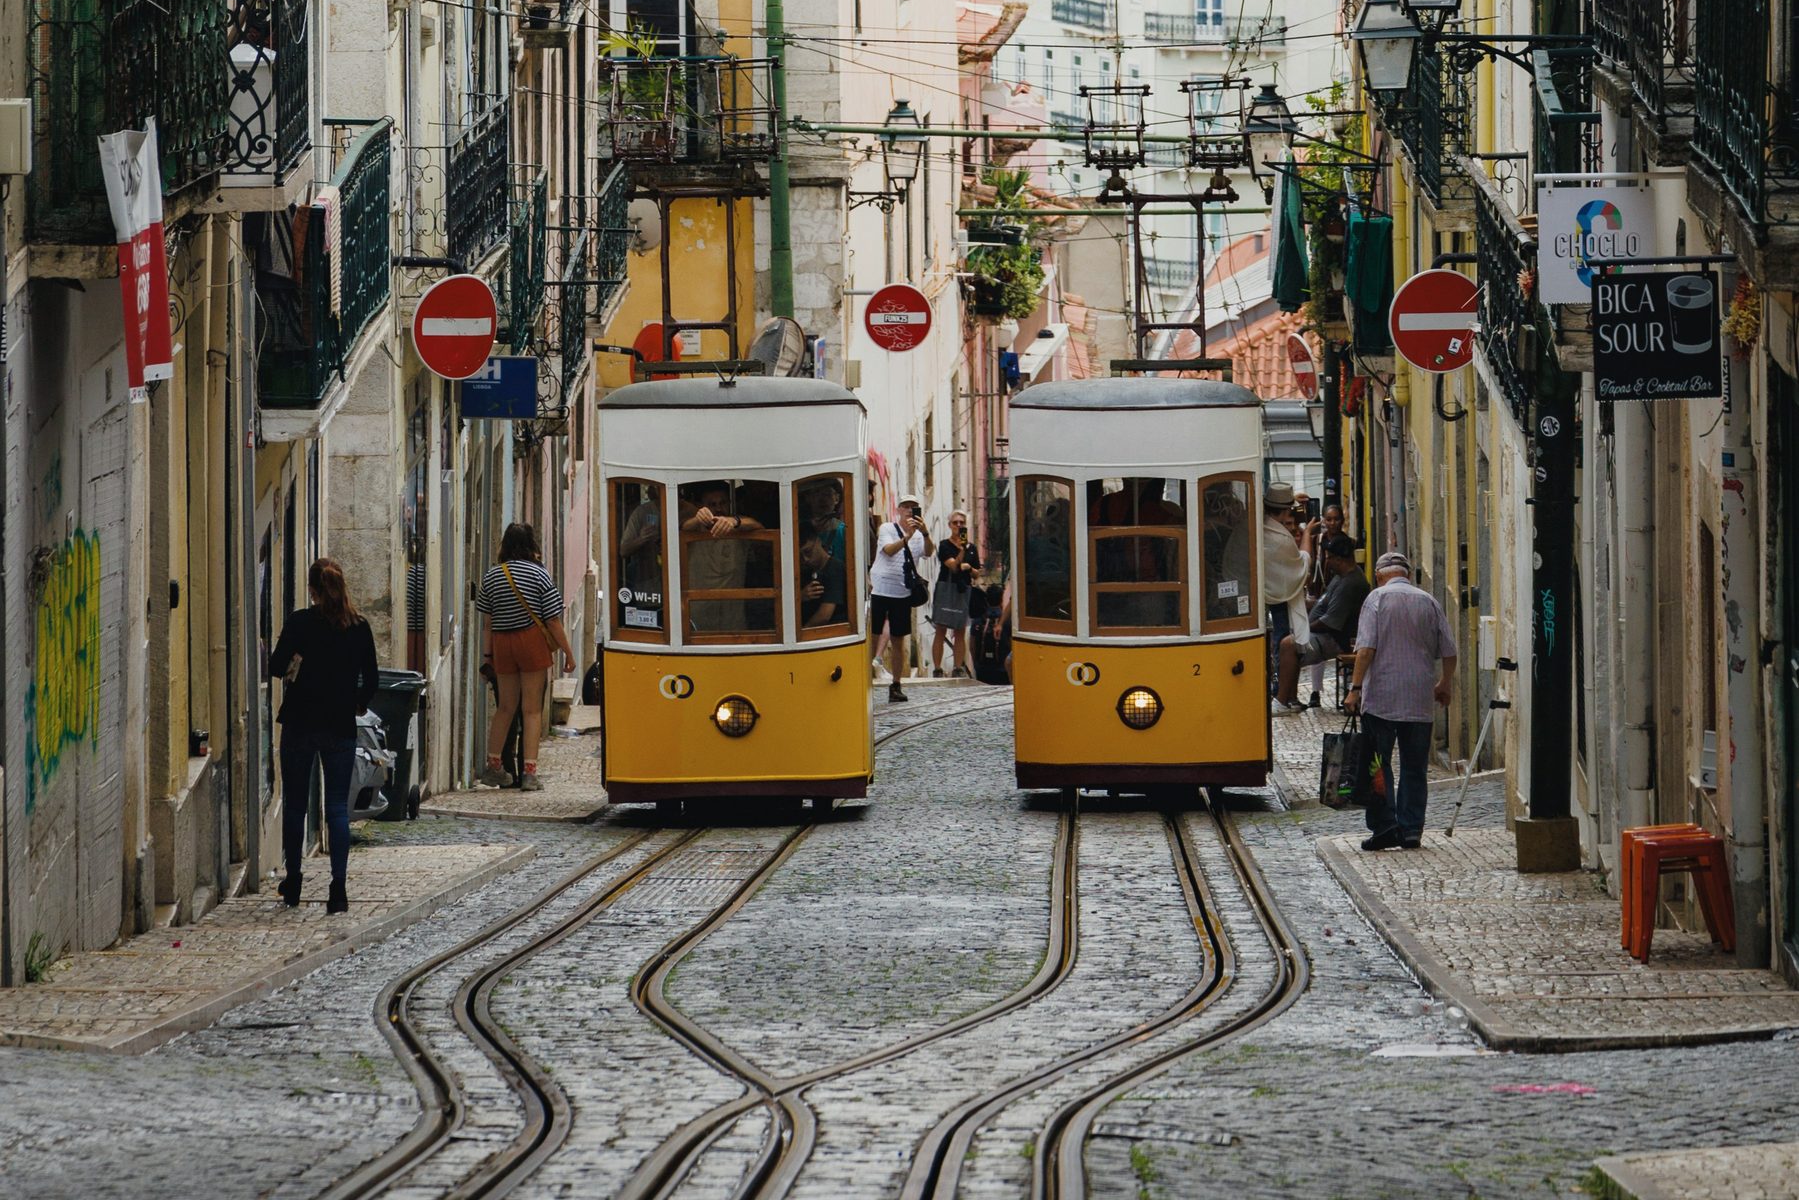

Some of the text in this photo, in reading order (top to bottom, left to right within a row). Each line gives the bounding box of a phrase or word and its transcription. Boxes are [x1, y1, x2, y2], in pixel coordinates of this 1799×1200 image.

[1555, 232, 1640, 258] CHOCLO
[1598, 283, 1655, 314] BICA
[1599, 322, 1665, 354] SOUR
[1600, 375, 1713, 397] Tapas & Cocktail Bar
[634, 591, 661, 604] WI-FI
[789, 671, 794, 685] 1
[1192, 663, 1201, 676] 2
